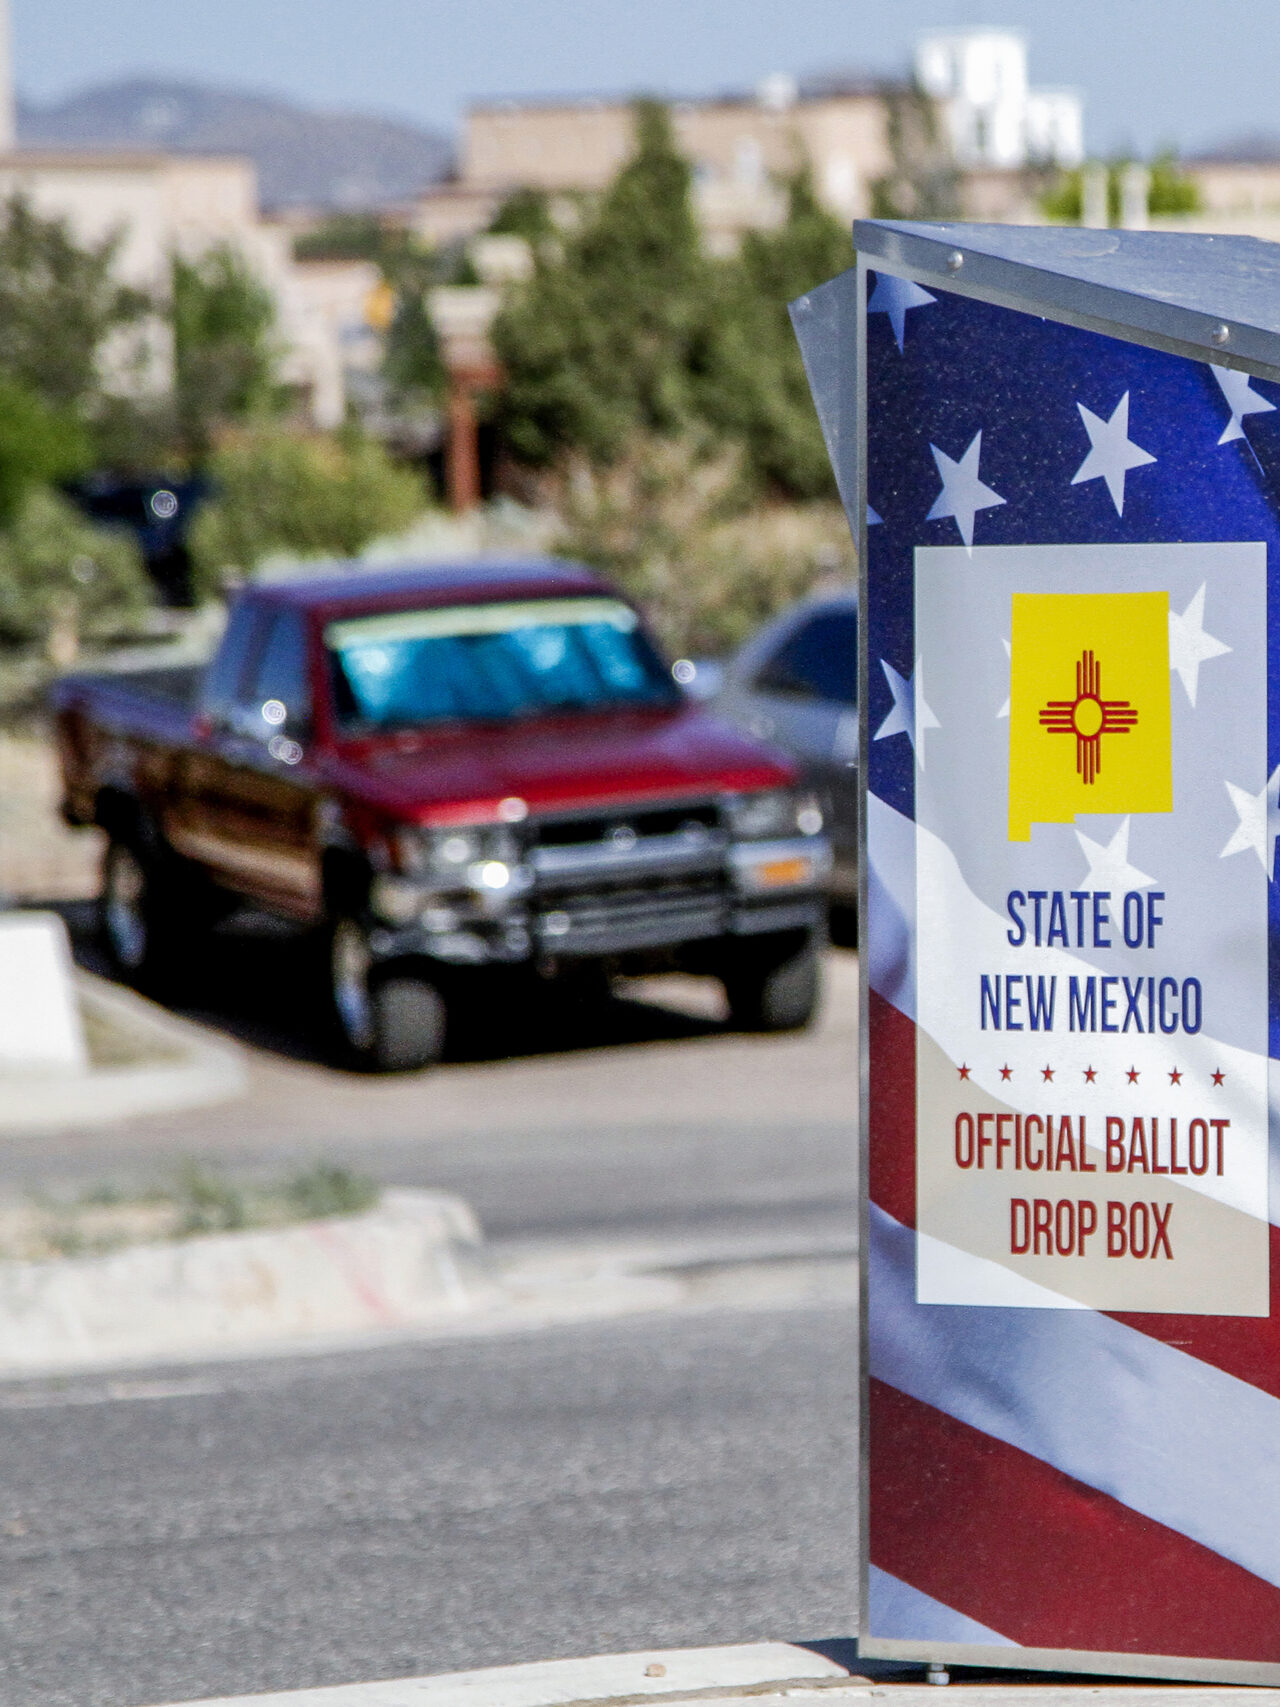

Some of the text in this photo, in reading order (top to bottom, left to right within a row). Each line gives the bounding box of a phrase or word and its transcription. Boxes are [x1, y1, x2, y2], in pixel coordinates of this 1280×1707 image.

[1006, 889, 1166, 949] STATE OF
[980, 974, 1203, 1035] NEW MEXICO
[954, 1111, 1231, 1177] OFFICIAL BALLOT
[1010, 1198, 1174, 1260] DROP BOX
